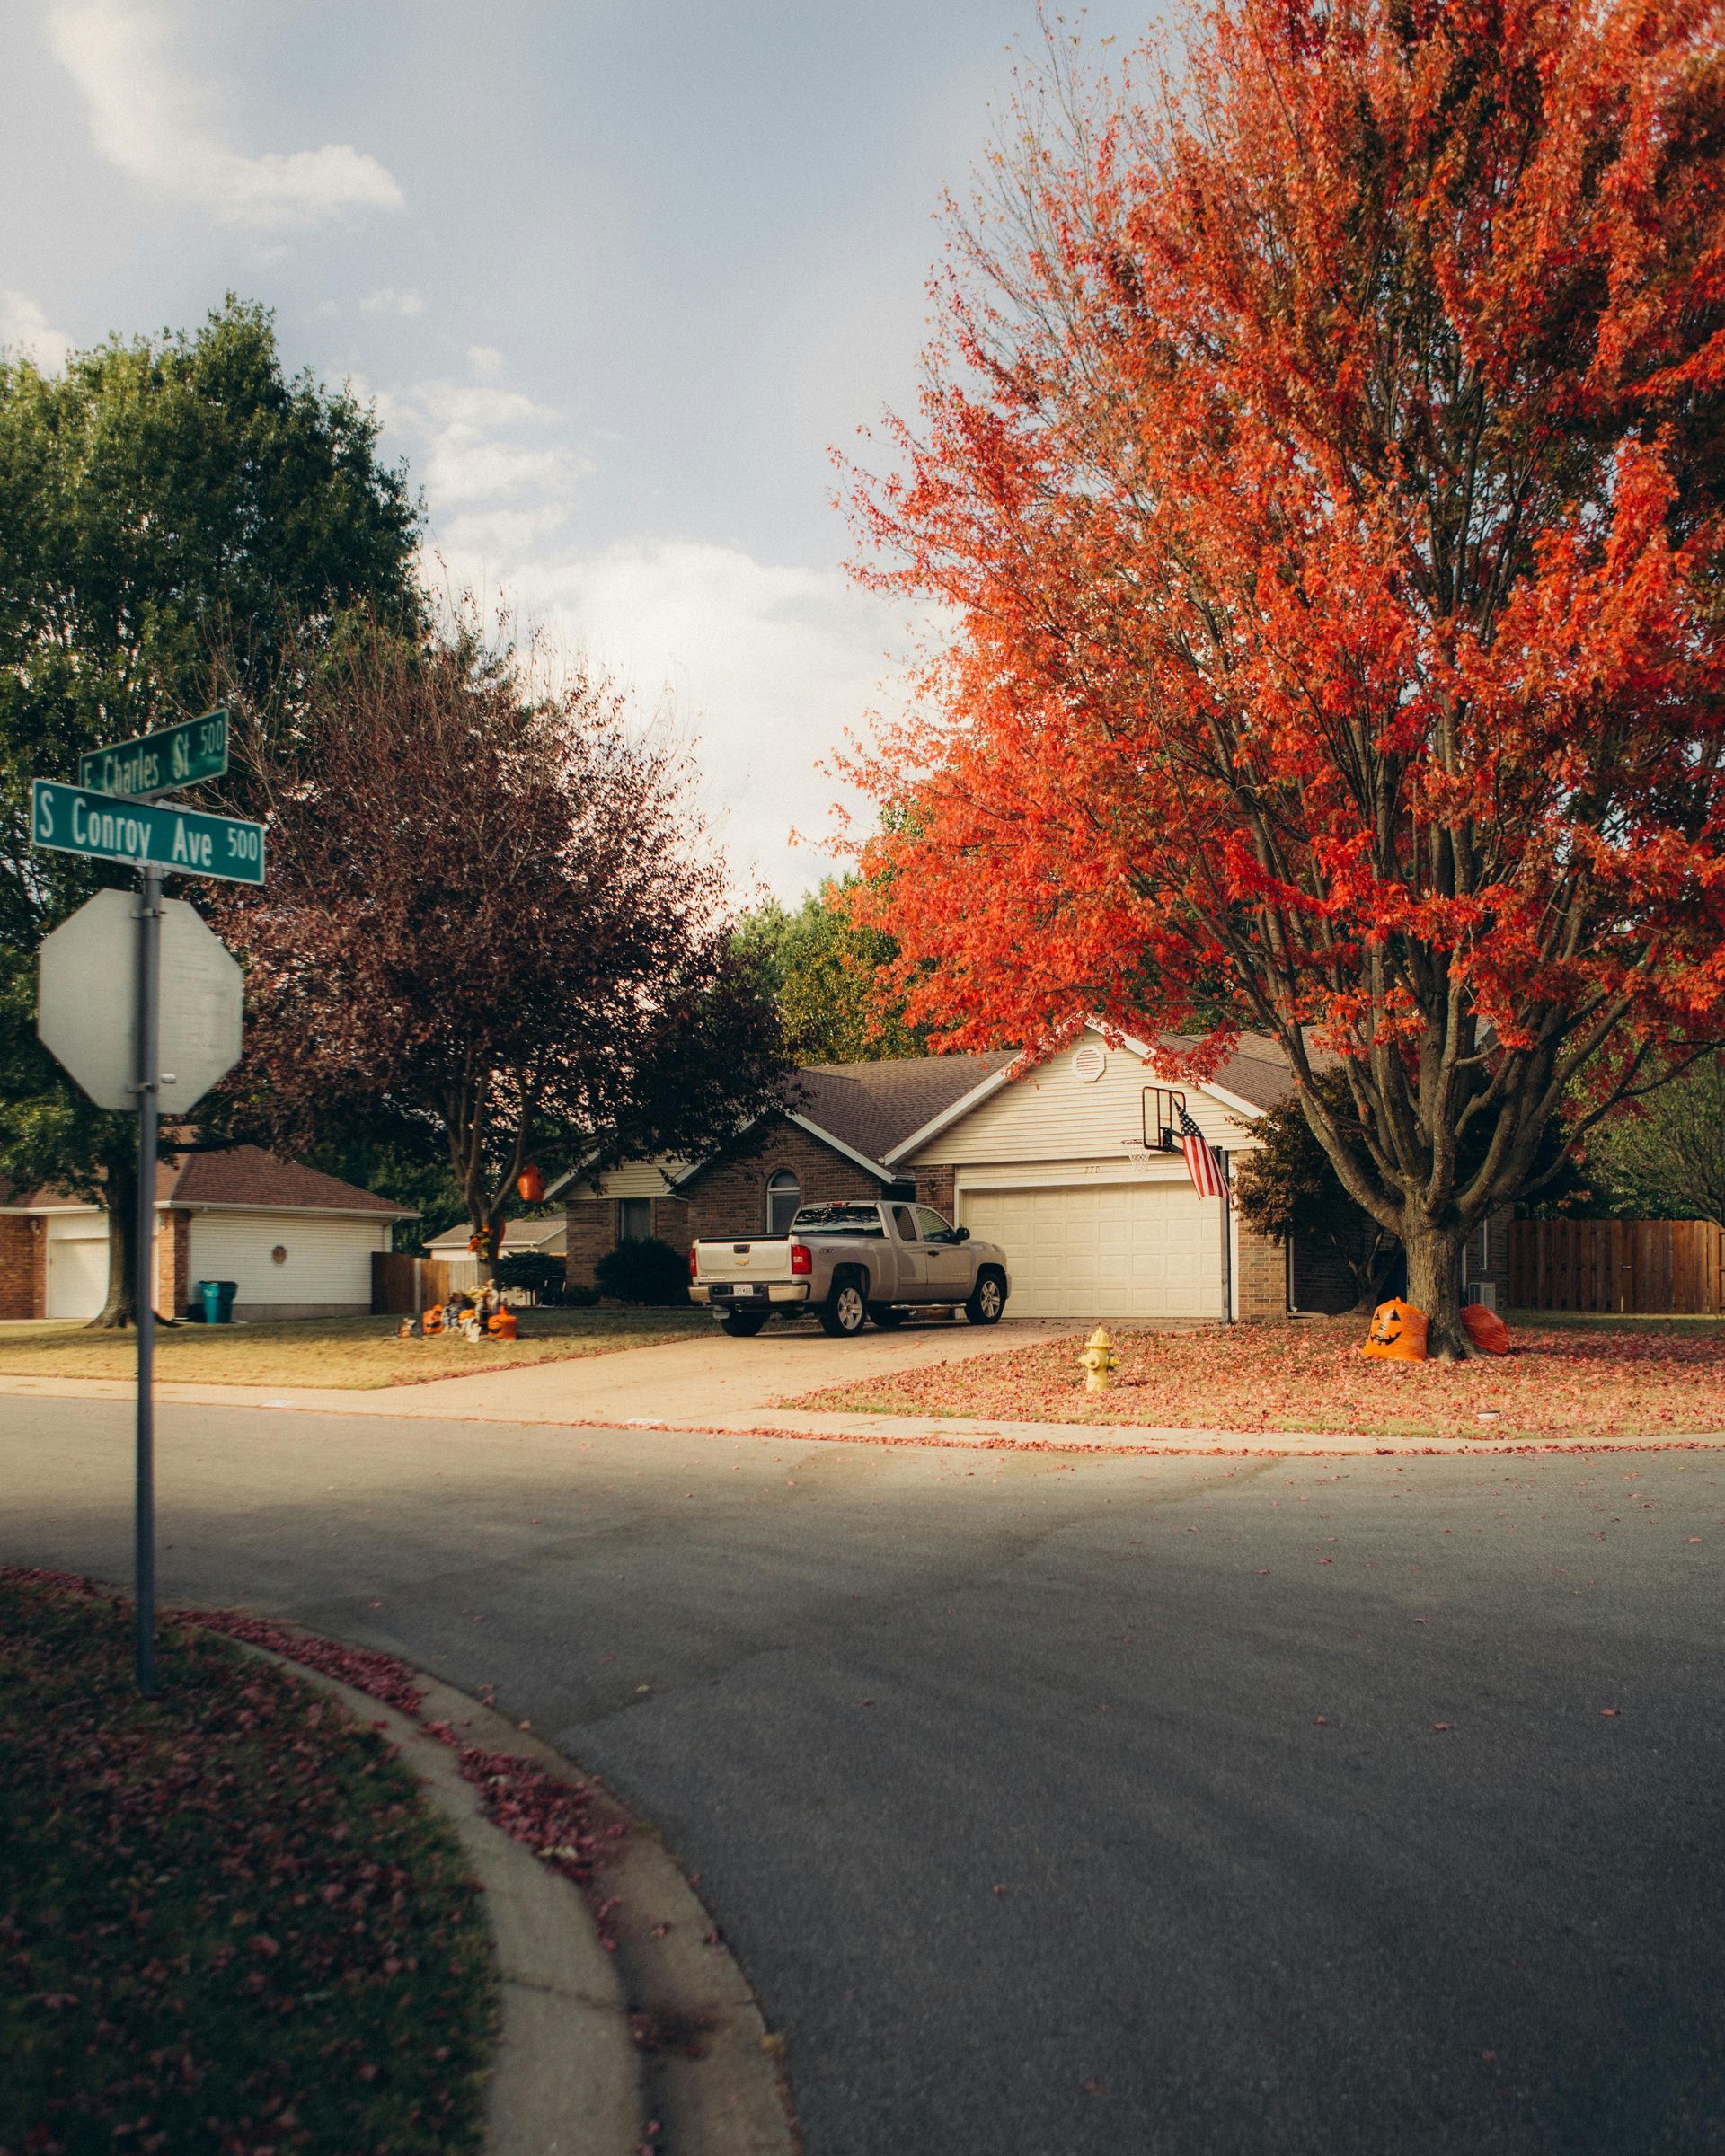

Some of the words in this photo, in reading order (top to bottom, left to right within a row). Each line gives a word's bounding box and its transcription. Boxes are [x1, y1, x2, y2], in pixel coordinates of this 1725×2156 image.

[102, 747, 159, 794] Charles
[173, 732, 190, 780] St
[200, 720, 224, 757] 500
[40, 790, 54, 838] S
[72, 797, 152, 859] Conroy
[172, 817, 212, 867] Ave
[226, 827, 259, 861] 500
